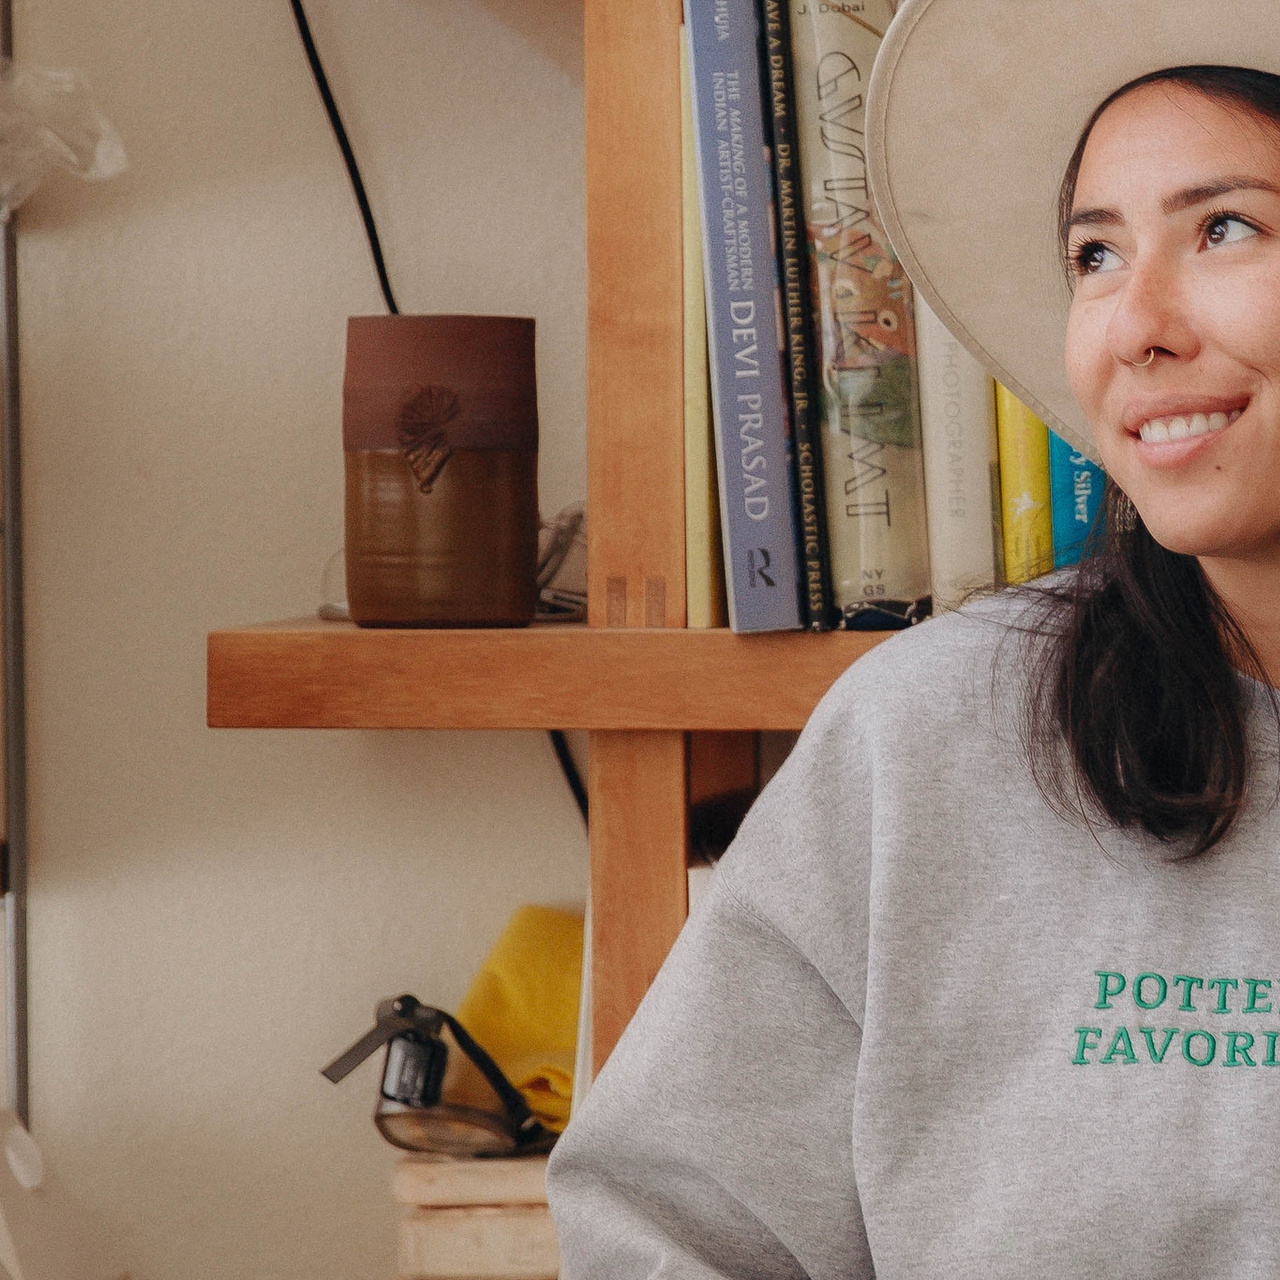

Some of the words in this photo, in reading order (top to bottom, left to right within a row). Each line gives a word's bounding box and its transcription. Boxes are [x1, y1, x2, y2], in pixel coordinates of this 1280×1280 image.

[818, 2, 866, 14] Dobai
[769, 37, 782, 50] A
[711, 71, 729, 132] INDIAN
[726, 71, 742, 102] THE
[769, 55, 788, 118] DREAM
[729, 107, 747, 174] MAKING
[777, 143, 792, 173] DR.
[717, 140, 741, 292] ARTIST-CRAFTSMAN
[733, 176, 748, 199] OF
[736, 203, 749, 216] A
[779, 179, 801, 251] MARTIN
[737, 220, 754, 292] MODERN
[784, 257, 803, 329] LUTHER
[729, 300, 761, 379] DEVI
[736, 393, 771, 521] PRASAD
[940, 342, 966, 520] PHOTOGRAPHER
[800, 441, 820, 558] SCHOLASTIC
[1073, 470, 1092, 524] Silver
[807, 560, 824, 611] PRESS
[862, 568, 884, 580] NY
[863, 585, 886, 597] GS
